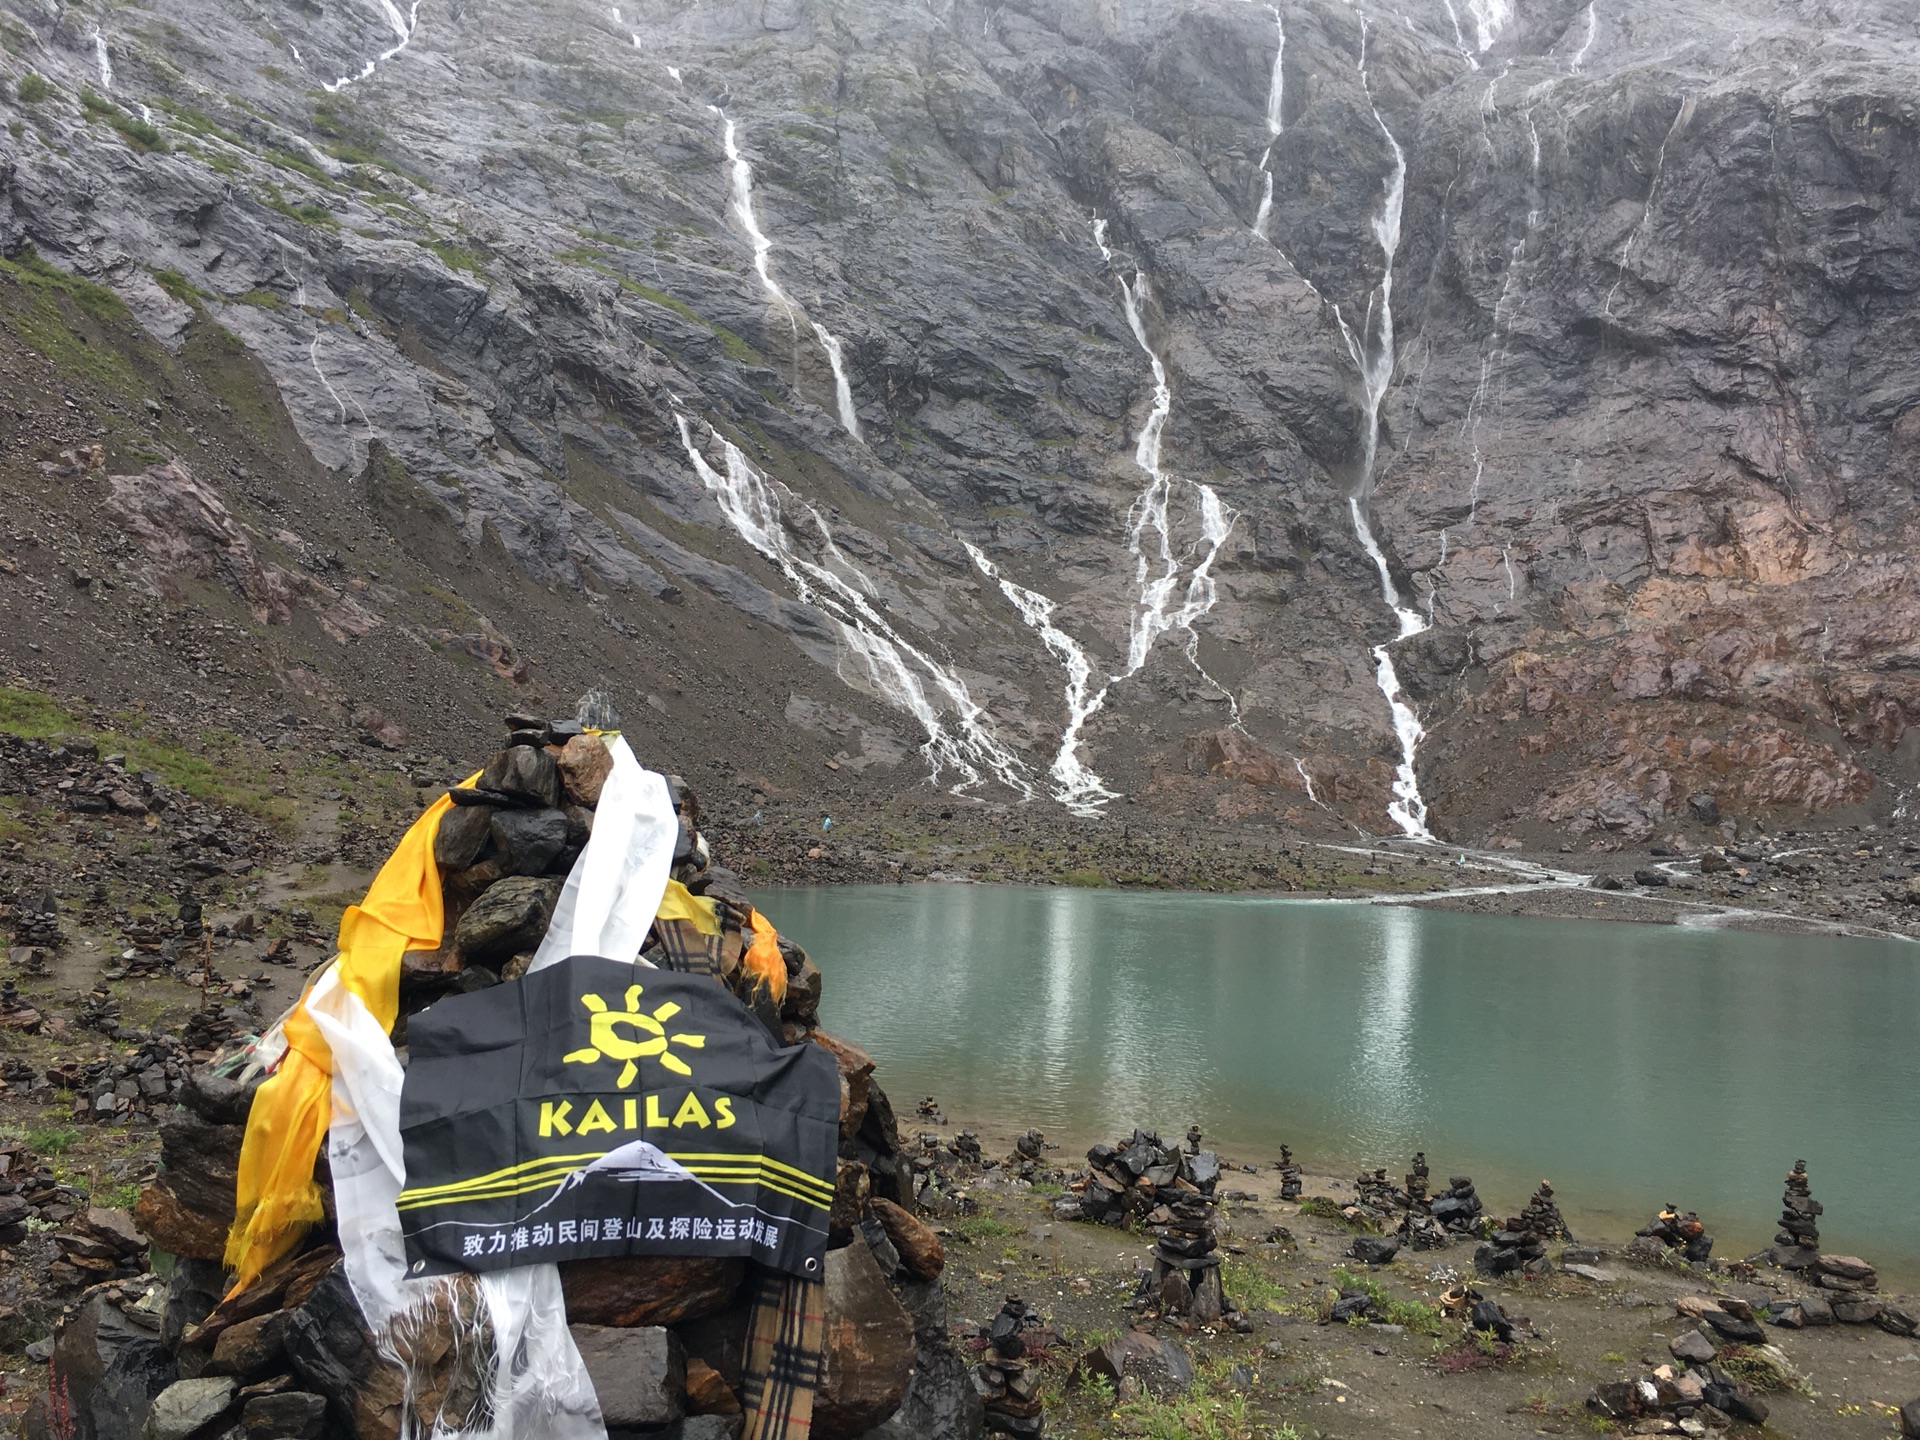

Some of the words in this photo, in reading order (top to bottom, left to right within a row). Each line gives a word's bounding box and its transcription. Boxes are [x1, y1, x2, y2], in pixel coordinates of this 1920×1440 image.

[538, 1091, 737, 1138] KAILAS
[462, 1216, 779, 1257] 致力推动民间登山及探险运动发展
